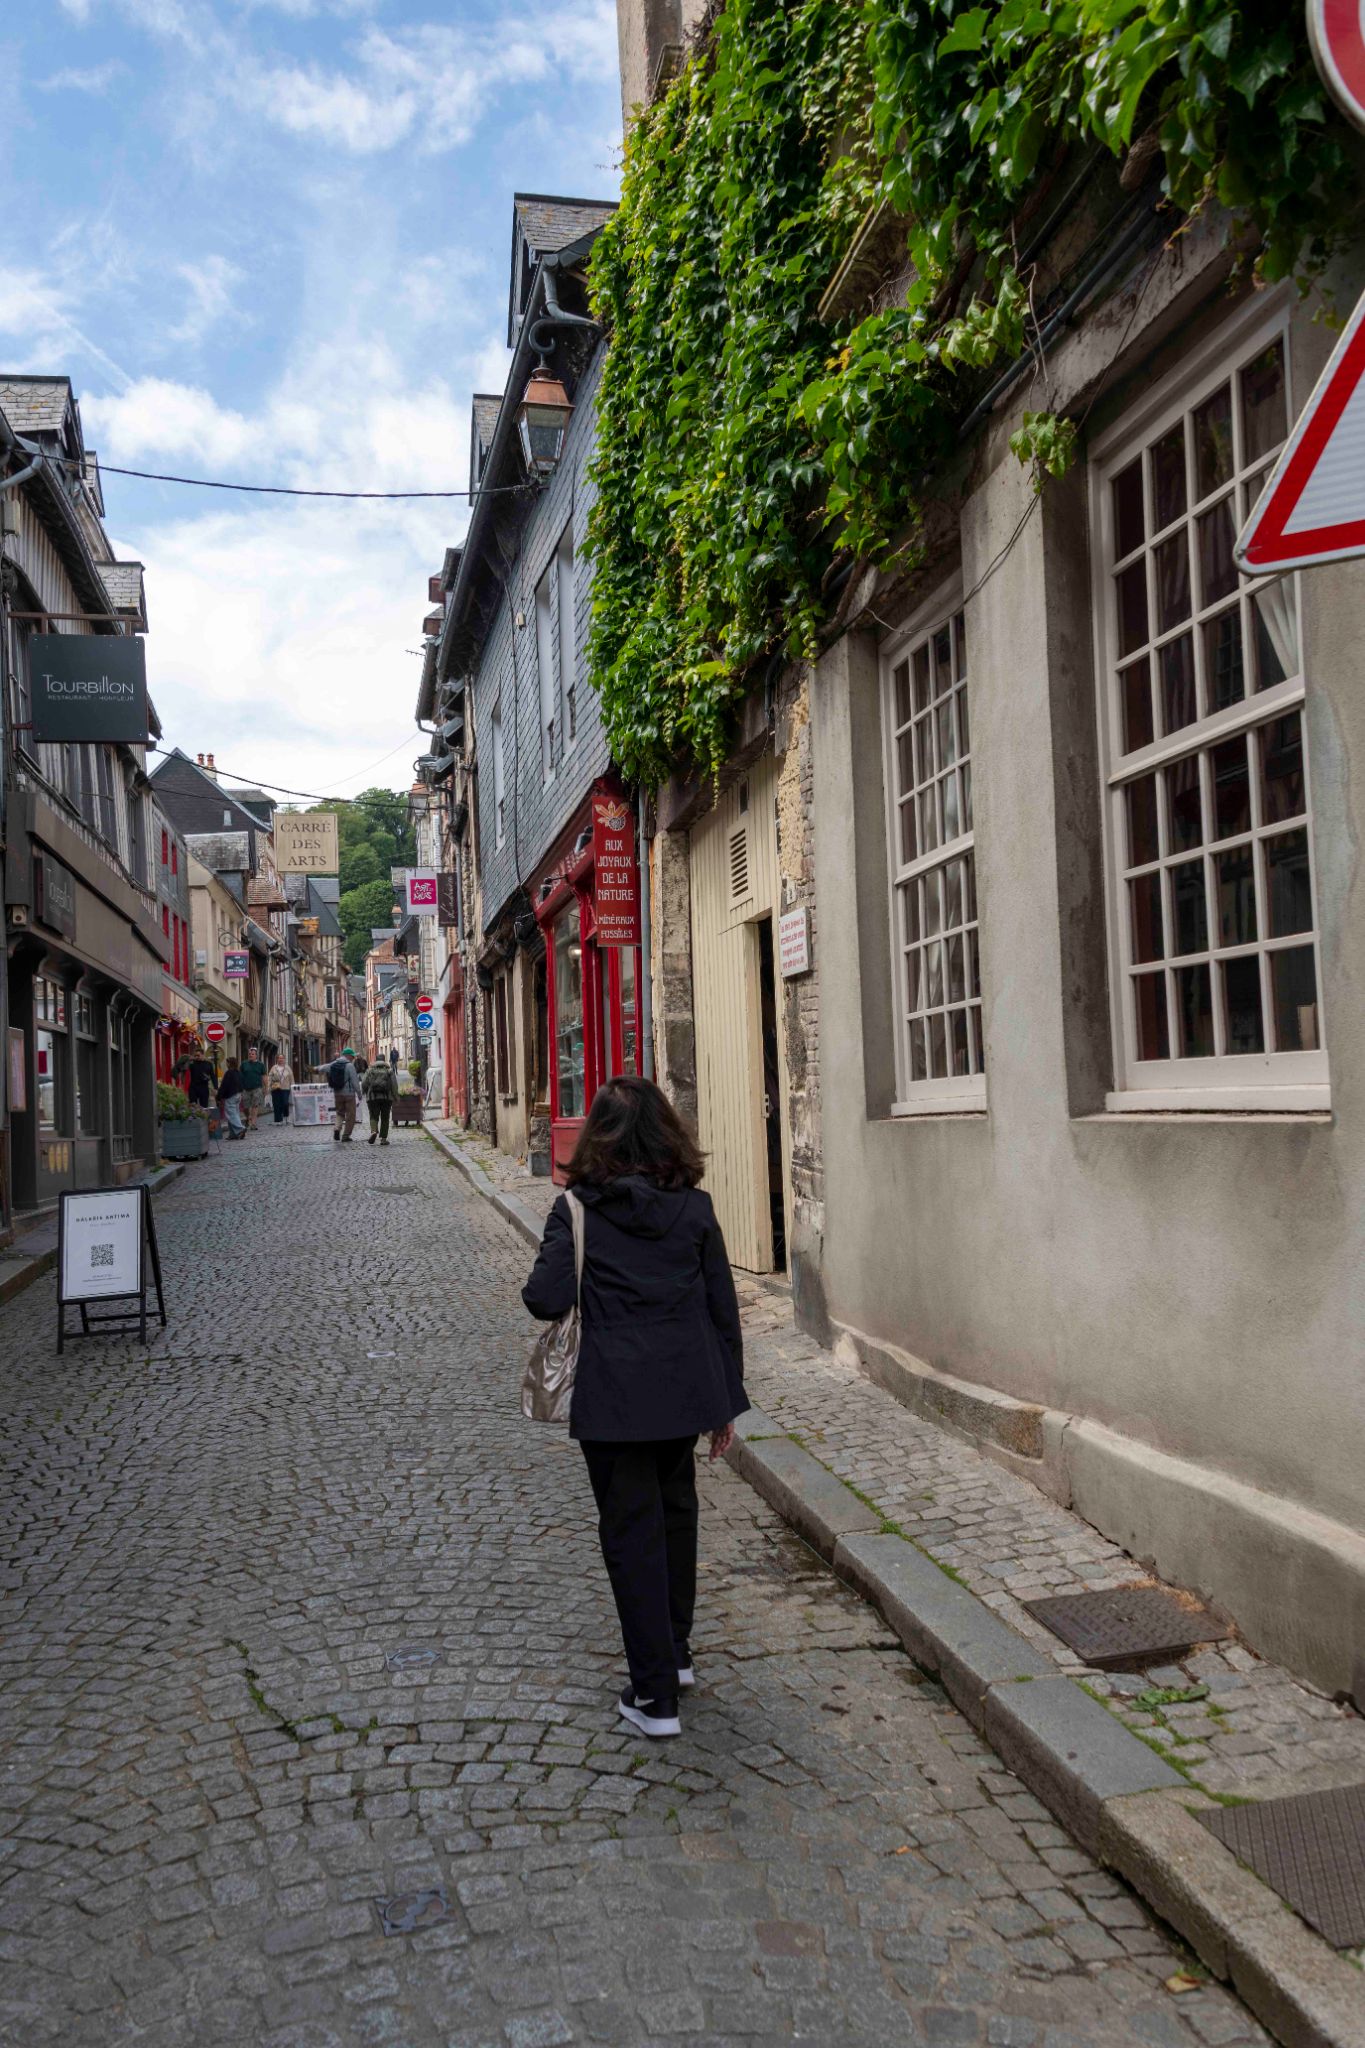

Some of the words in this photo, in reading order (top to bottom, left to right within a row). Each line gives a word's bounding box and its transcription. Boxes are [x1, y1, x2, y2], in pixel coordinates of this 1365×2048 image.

[280, 820, 332, 833] CARRÉ
[292, 839, 321, 849] DES
[605, 839, 623, 851] AUX
[287, 855, 327, 866] ARTS
[597, 855, 632, 867] JOYAUX
[602, 872, 615, 884] DE
[617, 872, 628, 884] LA
[597, 889, 634, 901] NATURE
[600, 928, 633, 939] FOSSILES
